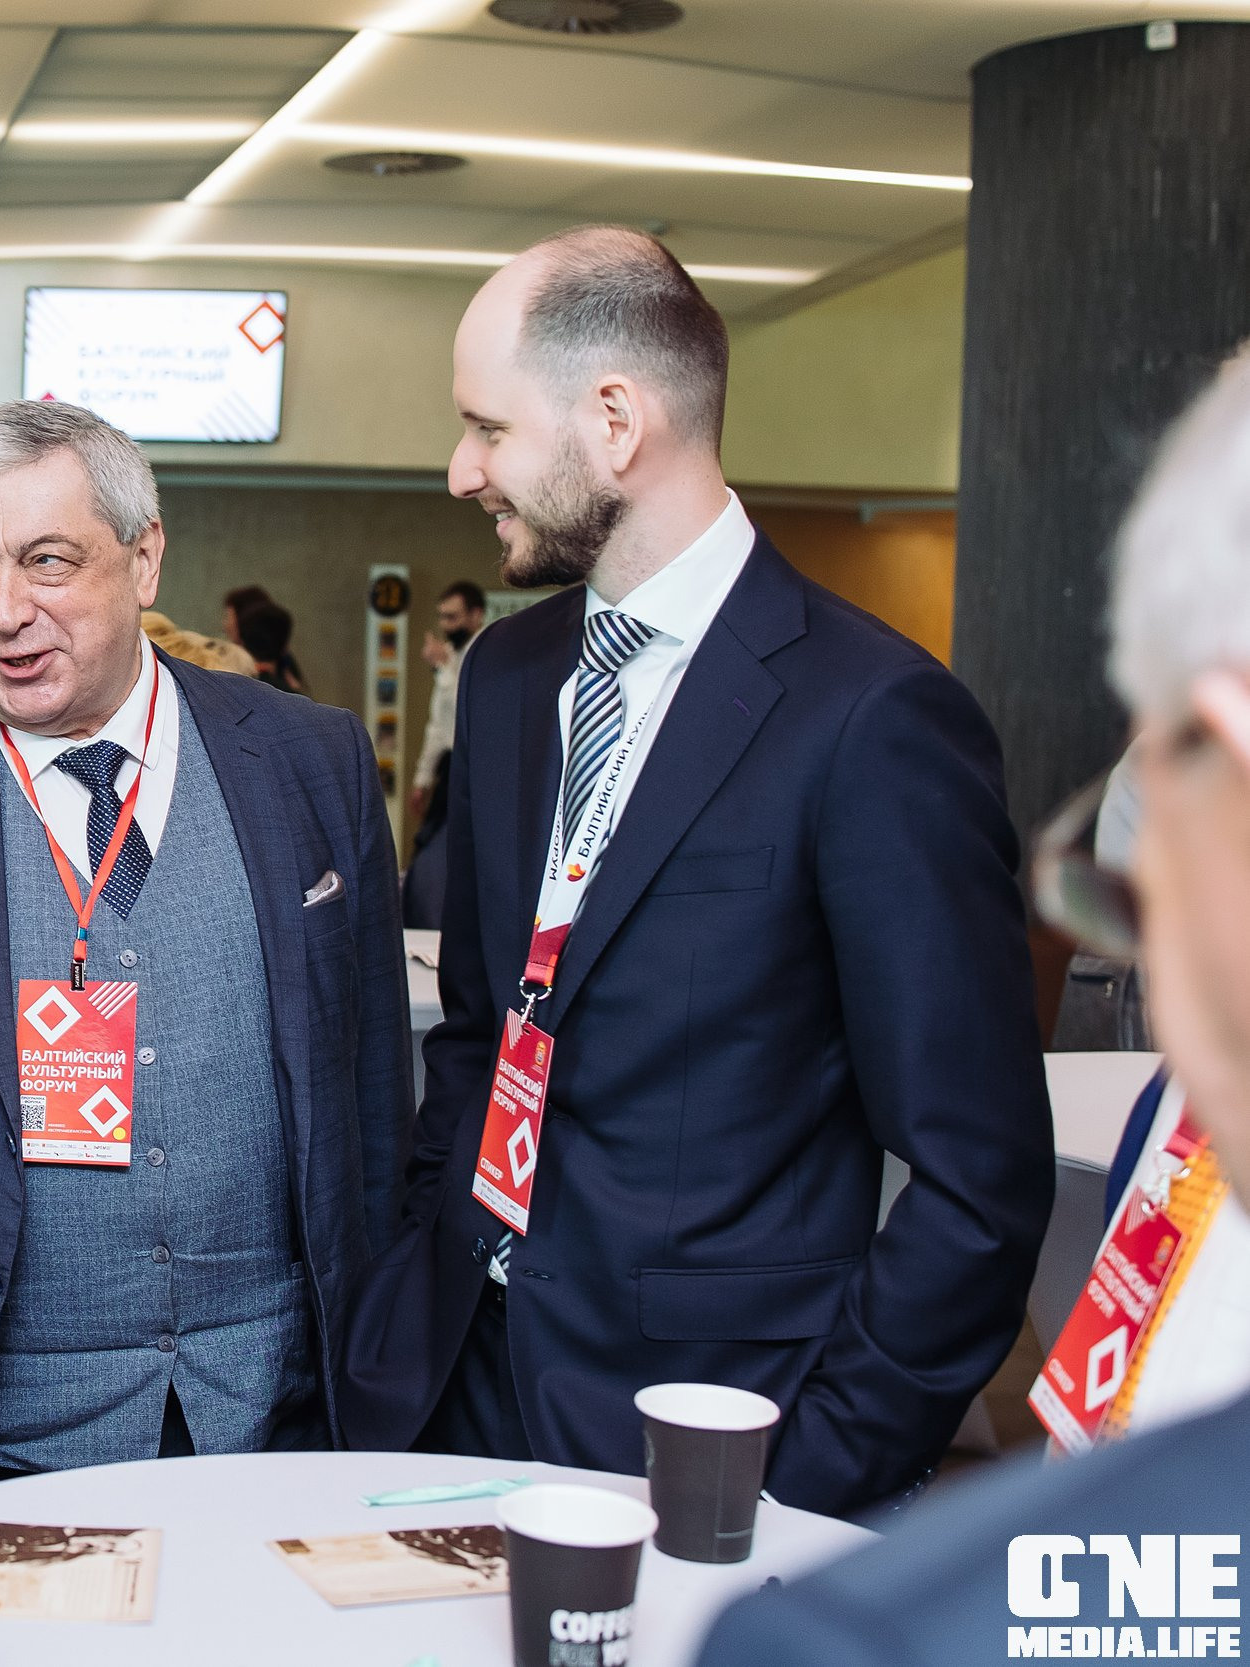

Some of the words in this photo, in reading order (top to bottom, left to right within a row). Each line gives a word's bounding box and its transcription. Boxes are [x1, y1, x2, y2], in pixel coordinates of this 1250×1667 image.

[578, 748, 629, 858] БАЛТИЙСКИЙ
[22, 1049, 126, 1065] БАЛТИЙСКИЙ
[20, 1064, 123, 1080] КУЛЬТУРНЫЙ
[20, 1079, 77, 1093] ФОРУМ
